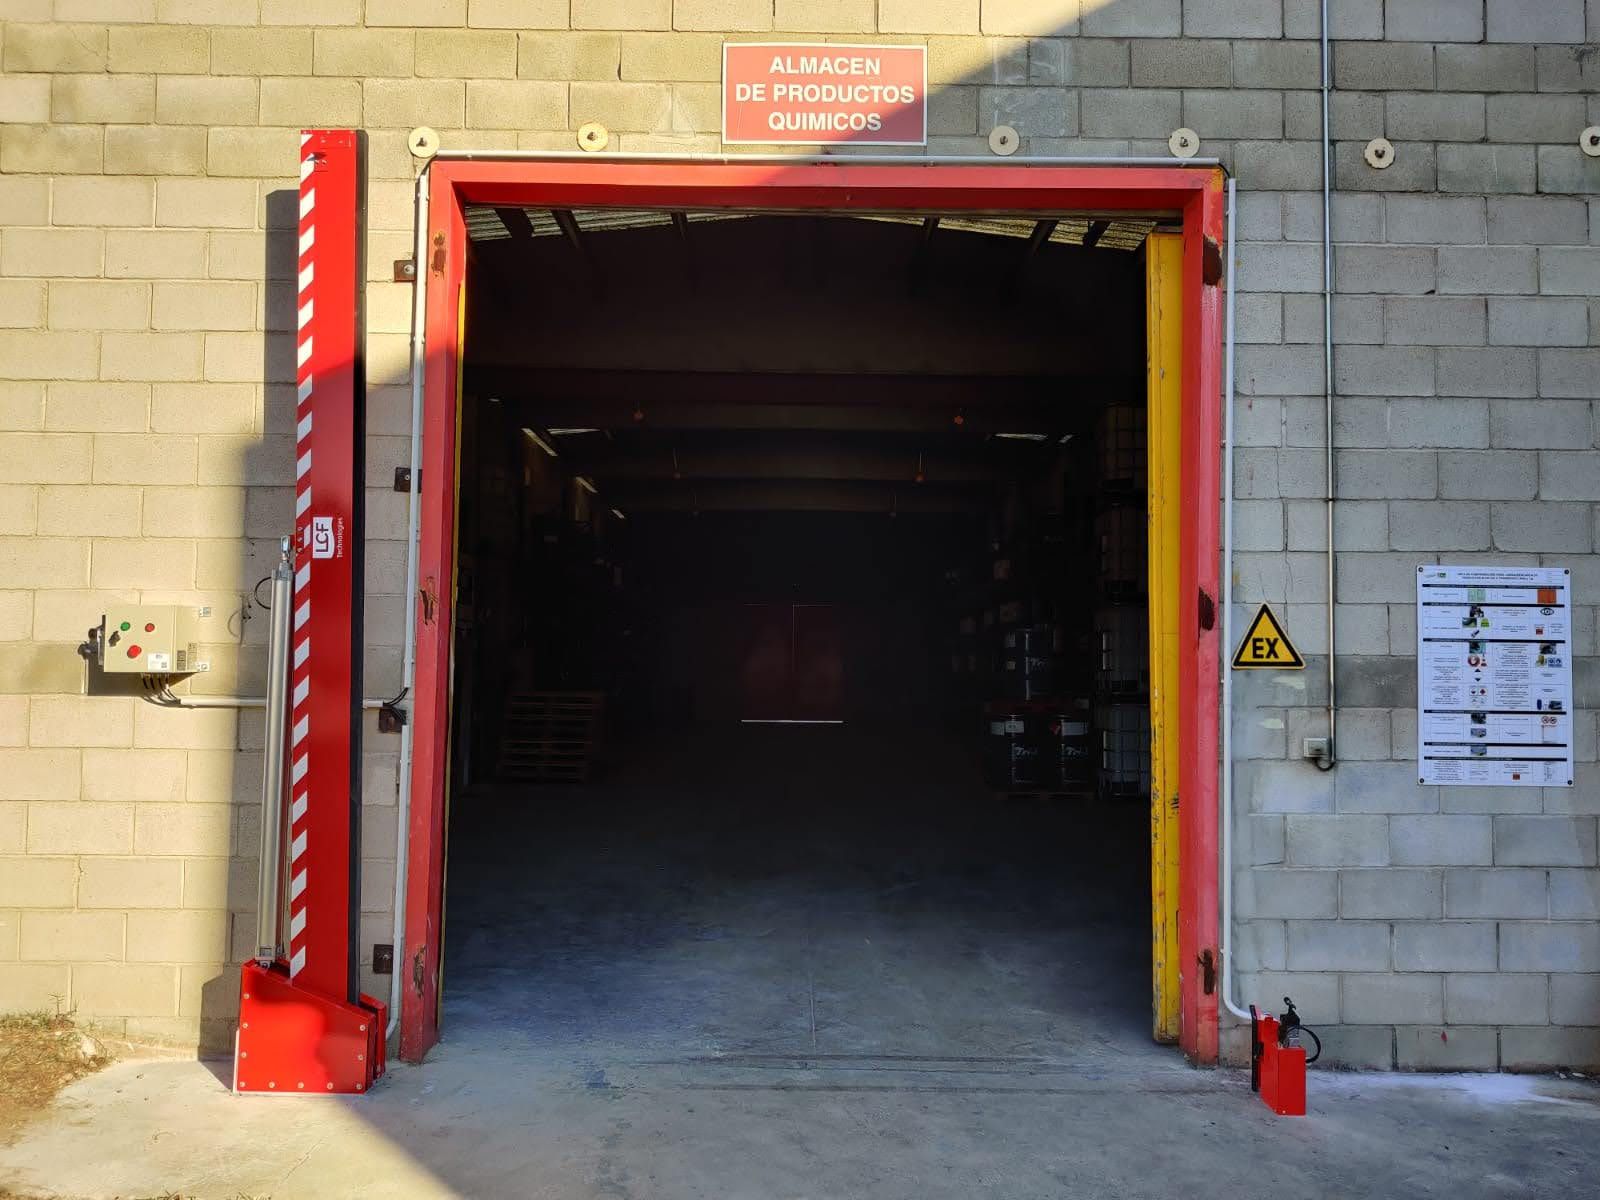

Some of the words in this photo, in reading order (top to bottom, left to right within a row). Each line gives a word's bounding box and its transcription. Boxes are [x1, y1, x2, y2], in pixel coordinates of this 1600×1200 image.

[769, 56, 881, 75] ALMACEN
[735, 83, 766, 102] DE
[773, 84, 915, 104] PRODUCTOS
[768, 111, 882, 131] QUIMICOS
[315, 522, 329, 553] LCF
[1252, 637, 1279, 659] EX
